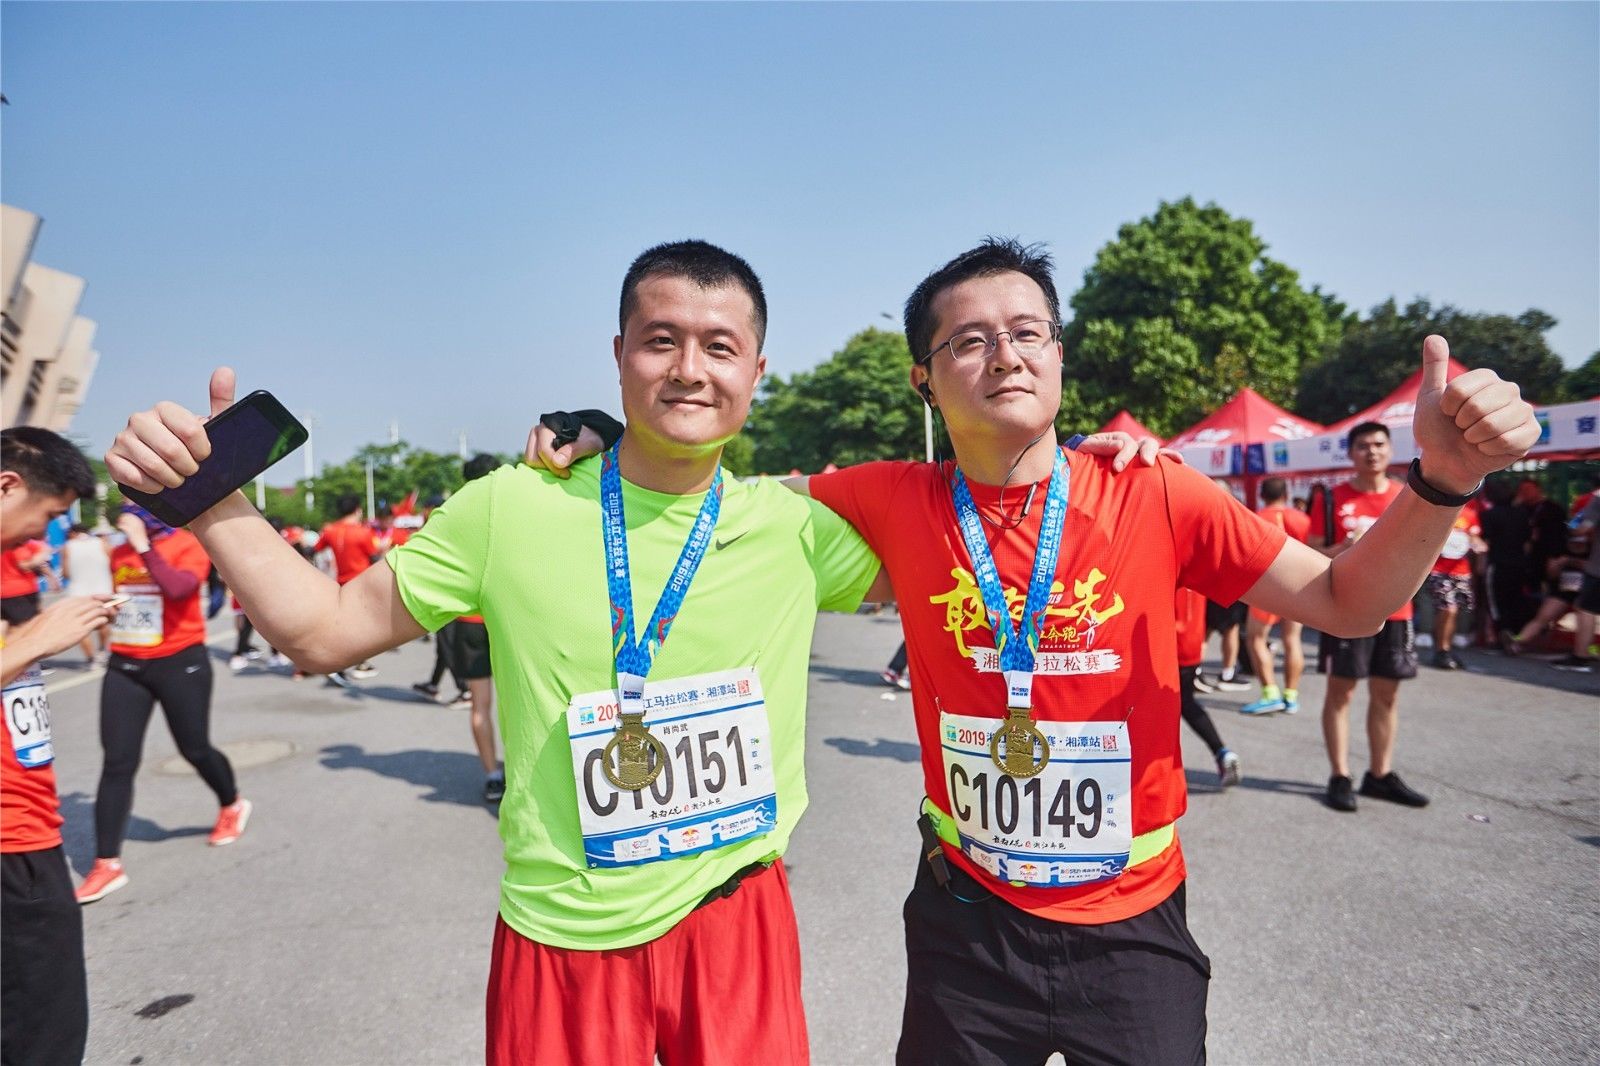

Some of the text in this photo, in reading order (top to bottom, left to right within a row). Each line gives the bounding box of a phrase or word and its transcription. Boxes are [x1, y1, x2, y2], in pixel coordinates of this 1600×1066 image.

[597, 703, 621, 722] 201
[959, 729, 985, 746] 2019
[950, 763, 1102, 839] C10149
